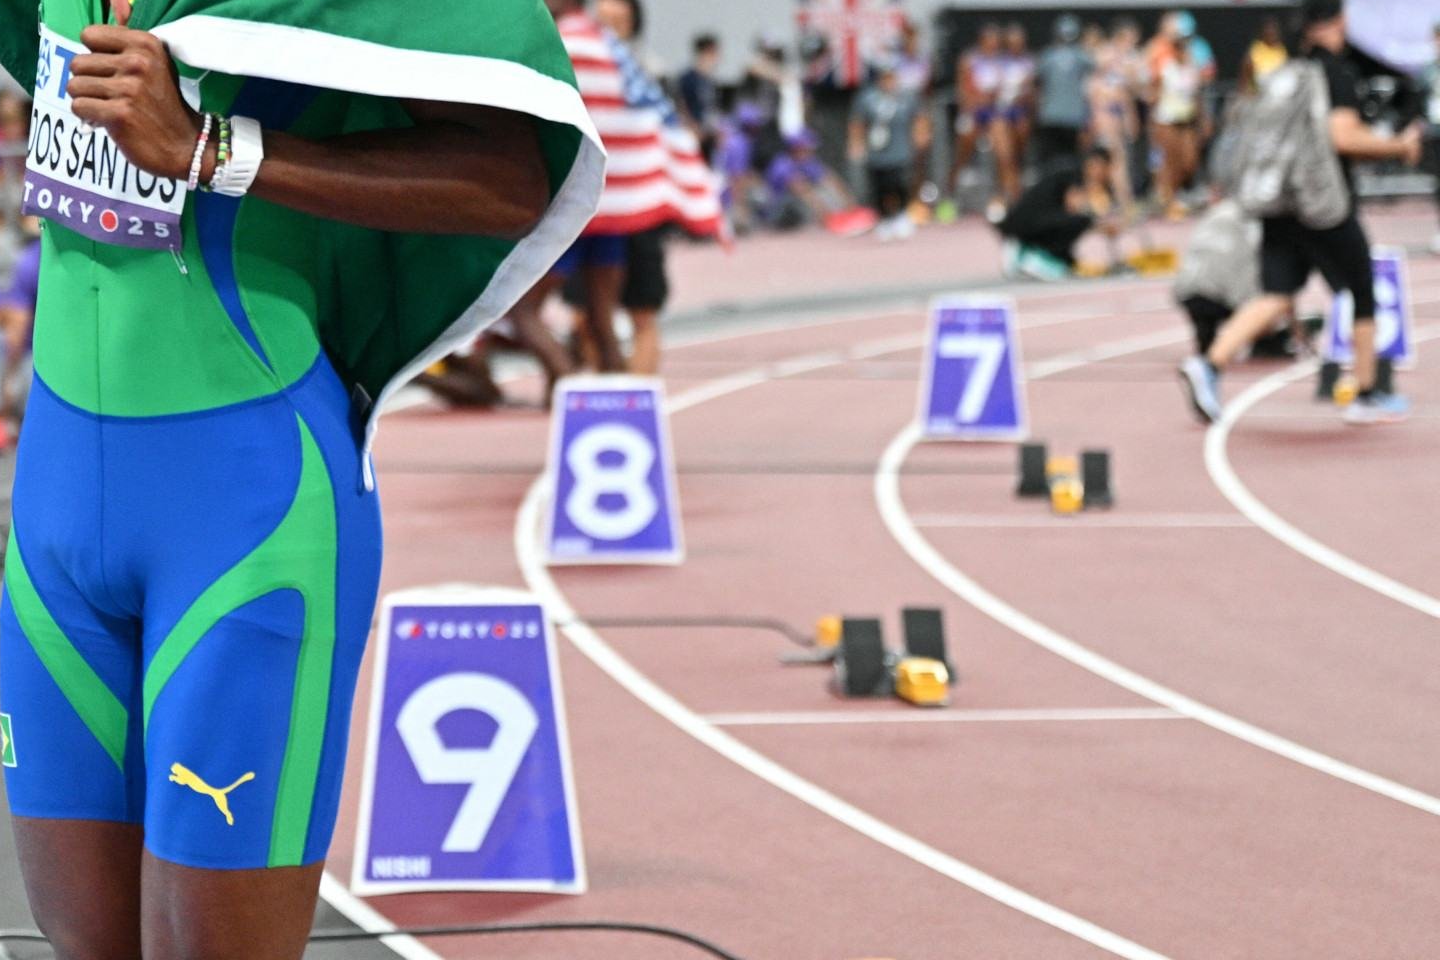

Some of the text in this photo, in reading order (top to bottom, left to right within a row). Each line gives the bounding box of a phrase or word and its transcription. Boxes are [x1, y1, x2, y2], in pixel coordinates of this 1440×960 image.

[939, 334, 1006, 424] 7
[566, 422, 659, 540] 8
[394, 672, 539, 852] 9
[371, 856, 431, 878] NISHI
